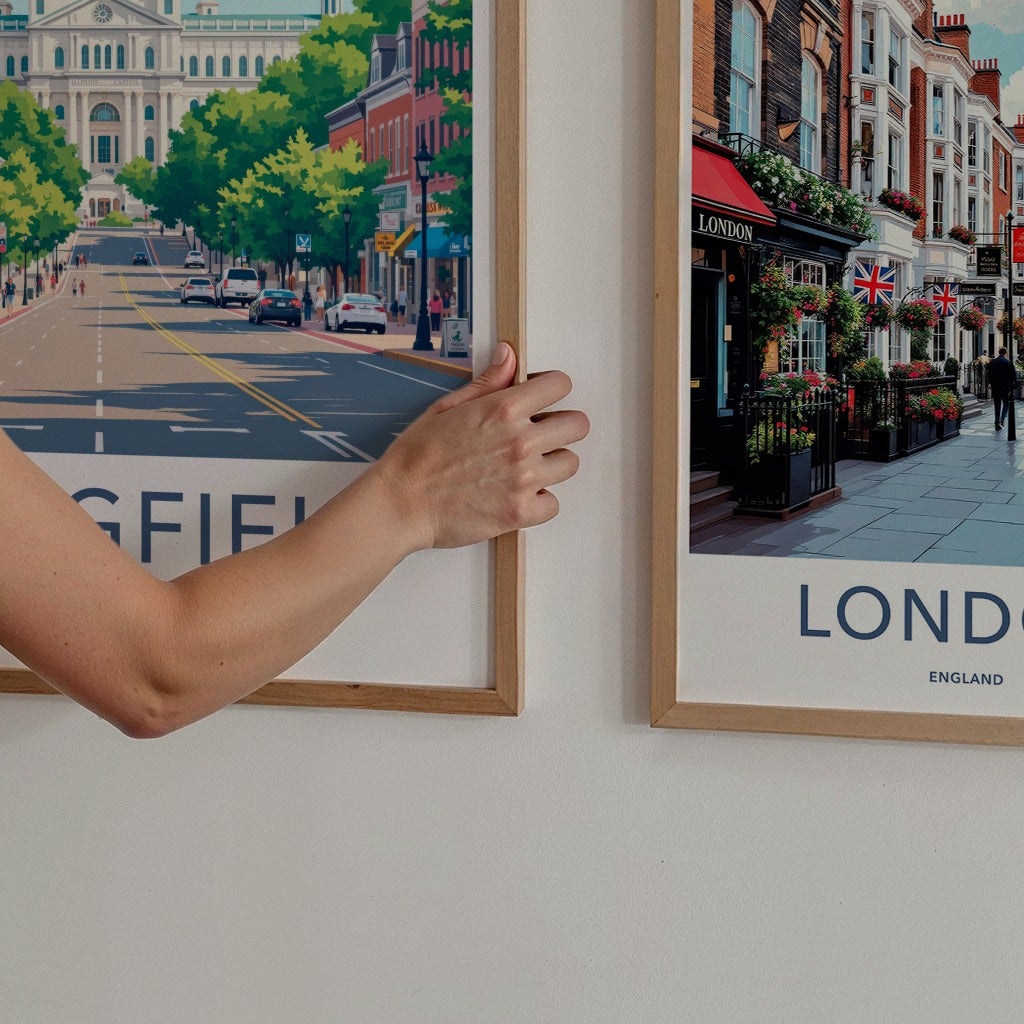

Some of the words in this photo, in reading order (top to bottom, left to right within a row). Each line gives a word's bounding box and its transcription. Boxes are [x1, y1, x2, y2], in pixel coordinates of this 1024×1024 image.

[698, 213, 753, 242] LONDON
[800, 584, 1024, 646] LOND
[929, 671, 1004, 686] ENGLAND
